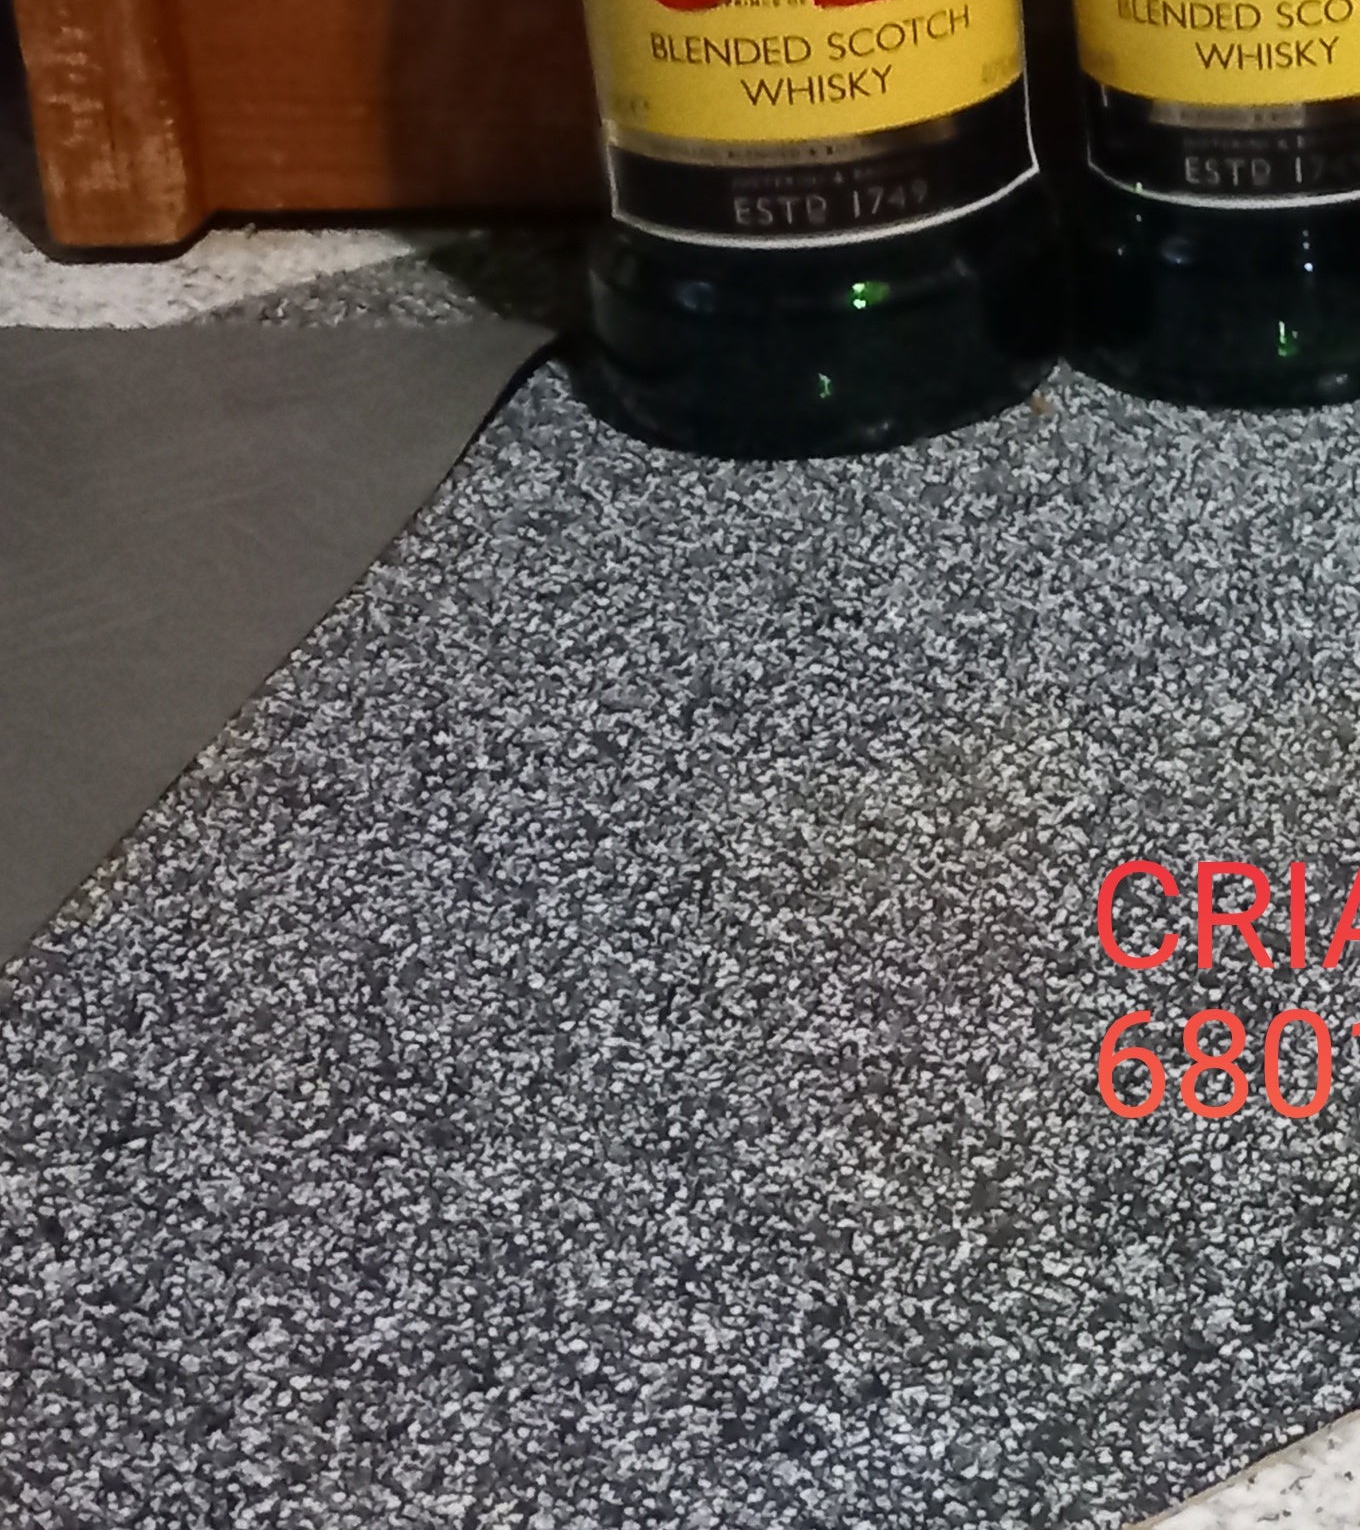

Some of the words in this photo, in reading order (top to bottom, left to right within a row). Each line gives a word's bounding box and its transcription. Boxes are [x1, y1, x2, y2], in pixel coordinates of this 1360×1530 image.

[650, 31, 812, 69] BLENDED
[828, 4, 972, 62] SCOTCH
[1195, 36, 1340, 71] WHISKY
[740, 64, 893, 107] WHISKY
